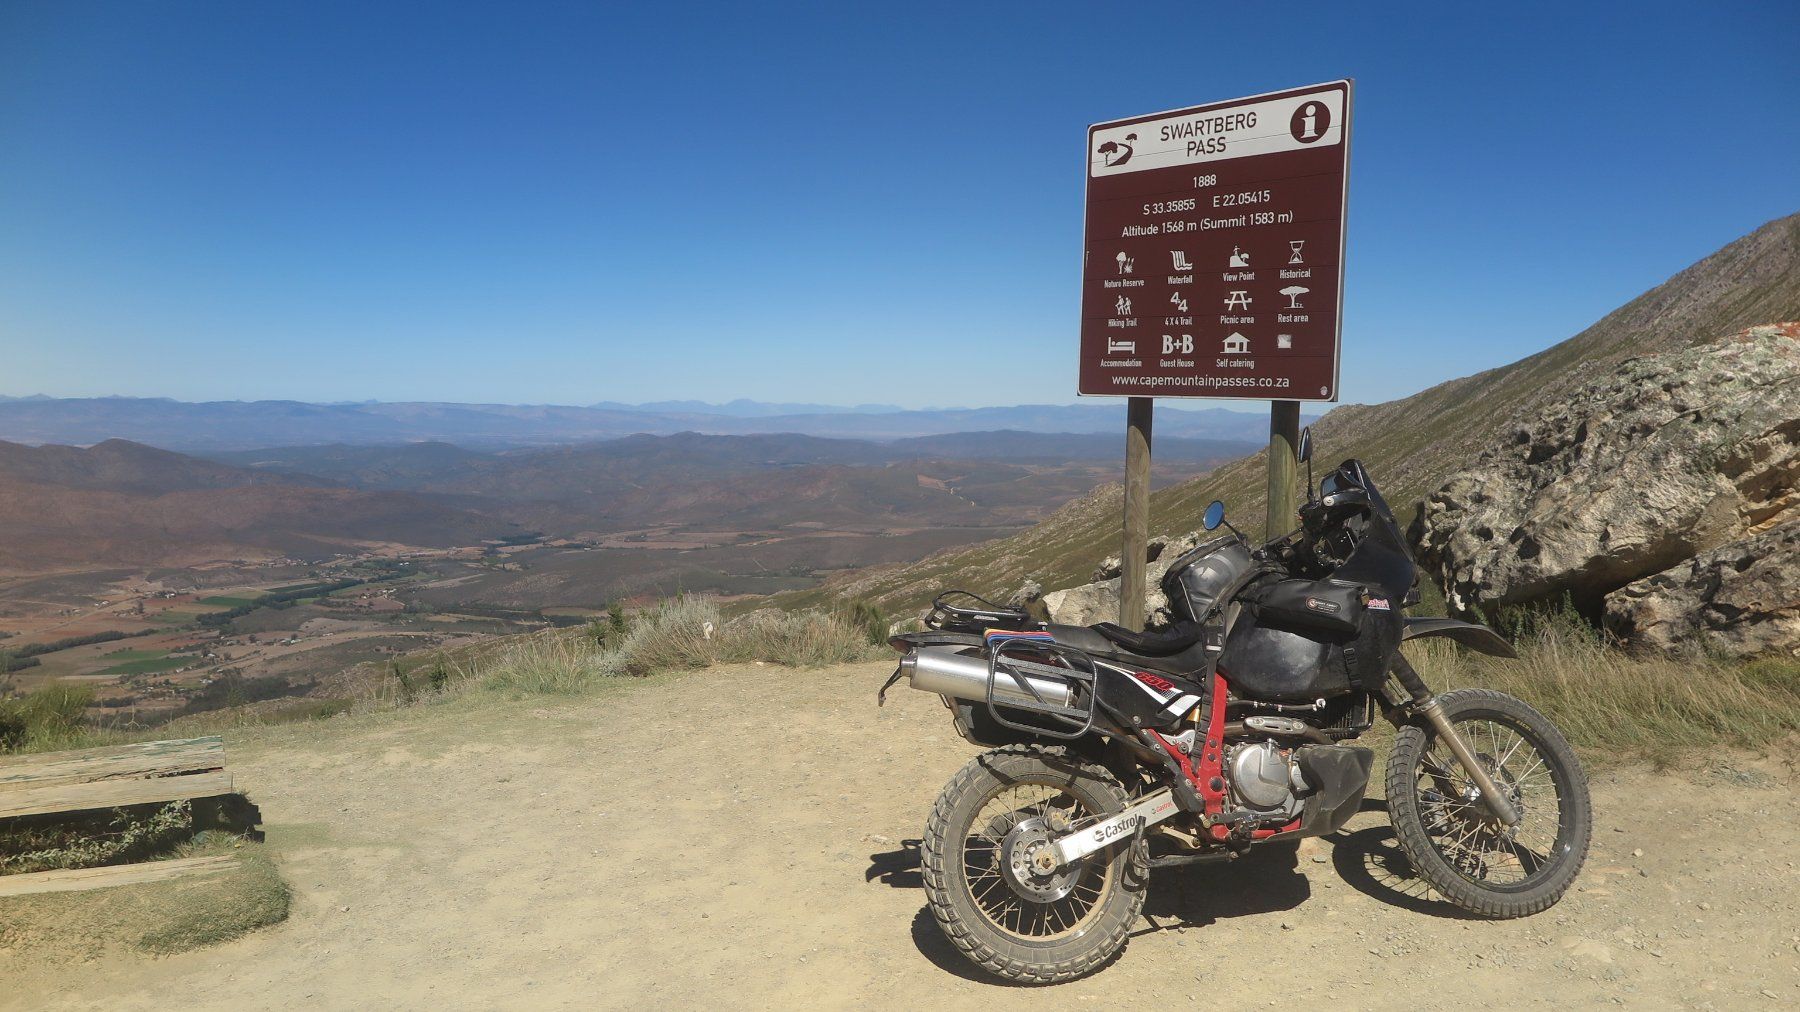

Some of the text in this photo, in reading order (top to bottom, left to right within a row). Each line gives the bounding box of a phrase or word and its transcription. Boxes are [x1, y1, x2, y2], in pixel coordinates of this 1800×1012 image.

[1160, 112, 1257, 141] SWARTBERG
[1187, 137, 1226, 157] PASS
[1193, 174, 1216, 188] 1888
[1143, 190, 1270, 215] S 33.35855 E 22.05415
[1122, 210, 1293, 237] Altitude 1568 m (Summit 1583 m)
[1222, 272, 1255, 281] View Point
[1280, 268, 1311, 279] Historical
[1104, 279, 1144, 288] Nature Reserve
[1168, 275, 1193, 284] Waterfall
[1165, 318, 1169, 326] 4
[1175, 317, 1179, 326] 4
[1180, 316, 1193, 326] Trail
[1220, 315, 1255, 324] Picnic area
[1278, 313, 1309, 322] Rest area
[1108, 318, 1137, 329] Hiking Trail
[1162, 334, 1194, 354] B+B
[1100, 359, 1142, 368] Accommodation
[1160, 359, 1194, 368] Guest House
[1216, 358, 1255, 369] Self catering
[1112, 374, 1290, 389] www.capemountainpasses.co.za
[1105, 814, 1138, 838] Castrol
